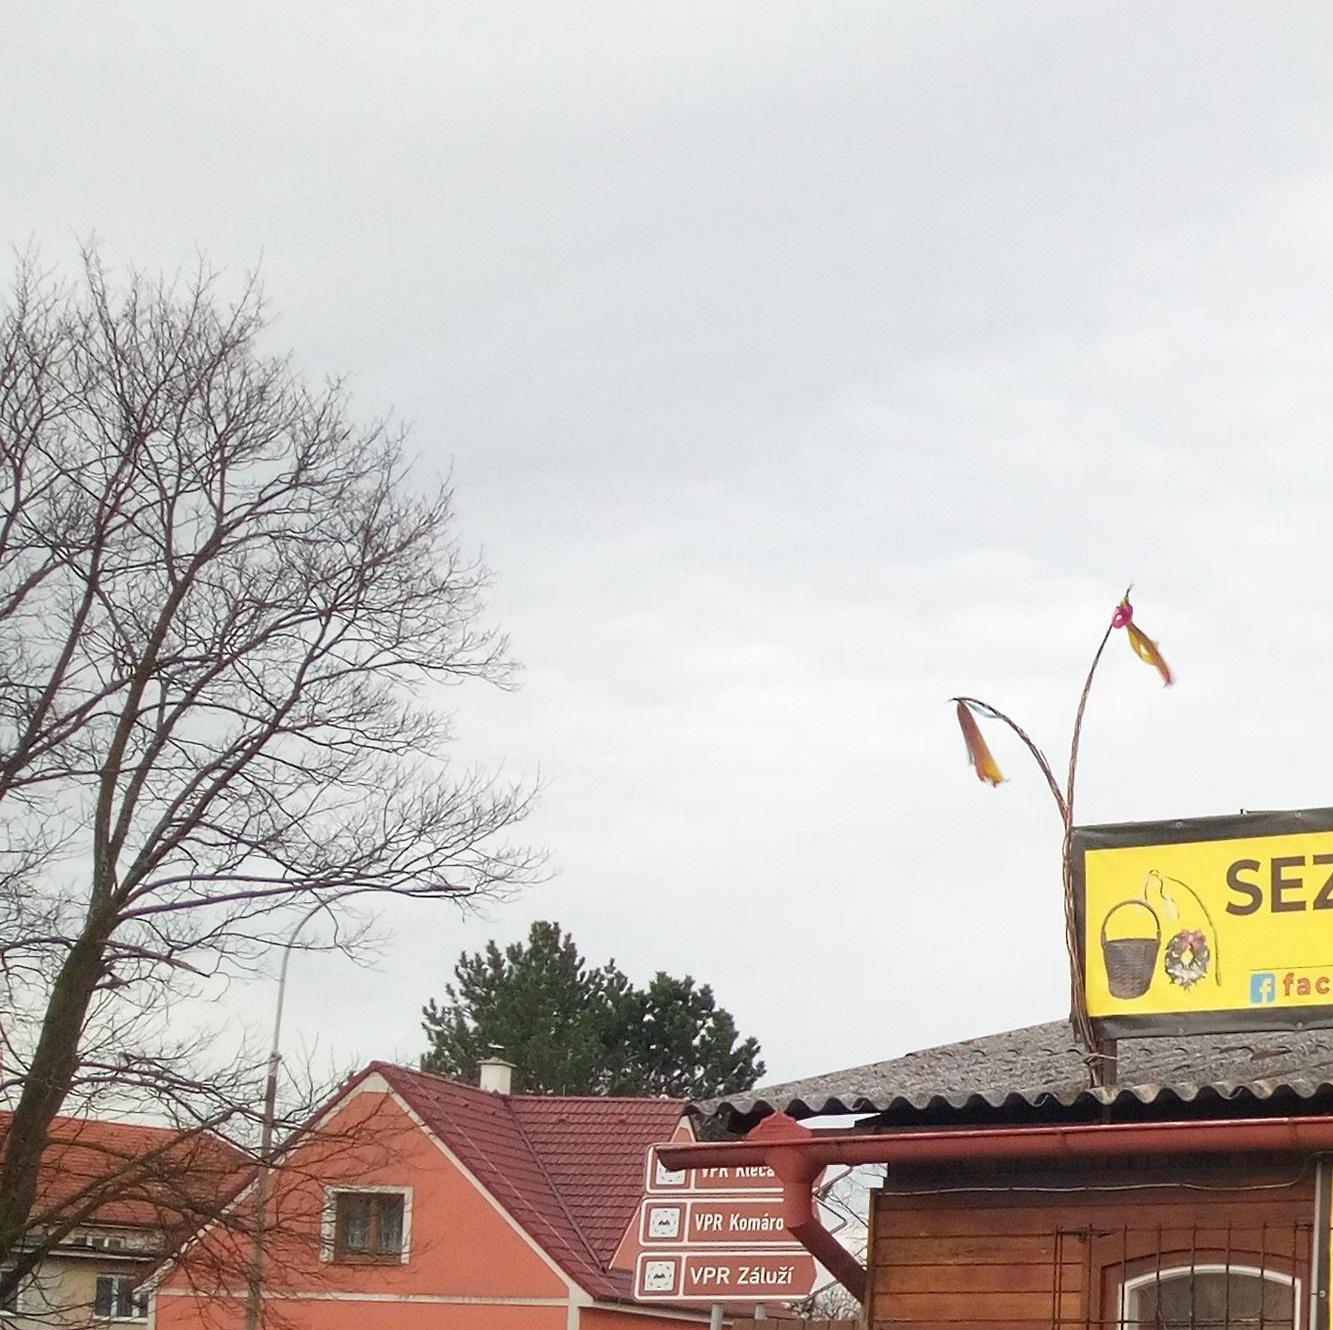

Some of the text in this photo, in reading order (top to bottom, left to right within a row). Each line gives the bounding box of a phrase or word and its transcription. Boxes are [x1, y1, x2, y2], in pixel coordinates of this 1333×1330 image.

[695, 1213, 723, 1231] VPR
[690, 1265, 795, 1285] VPR Záluží
